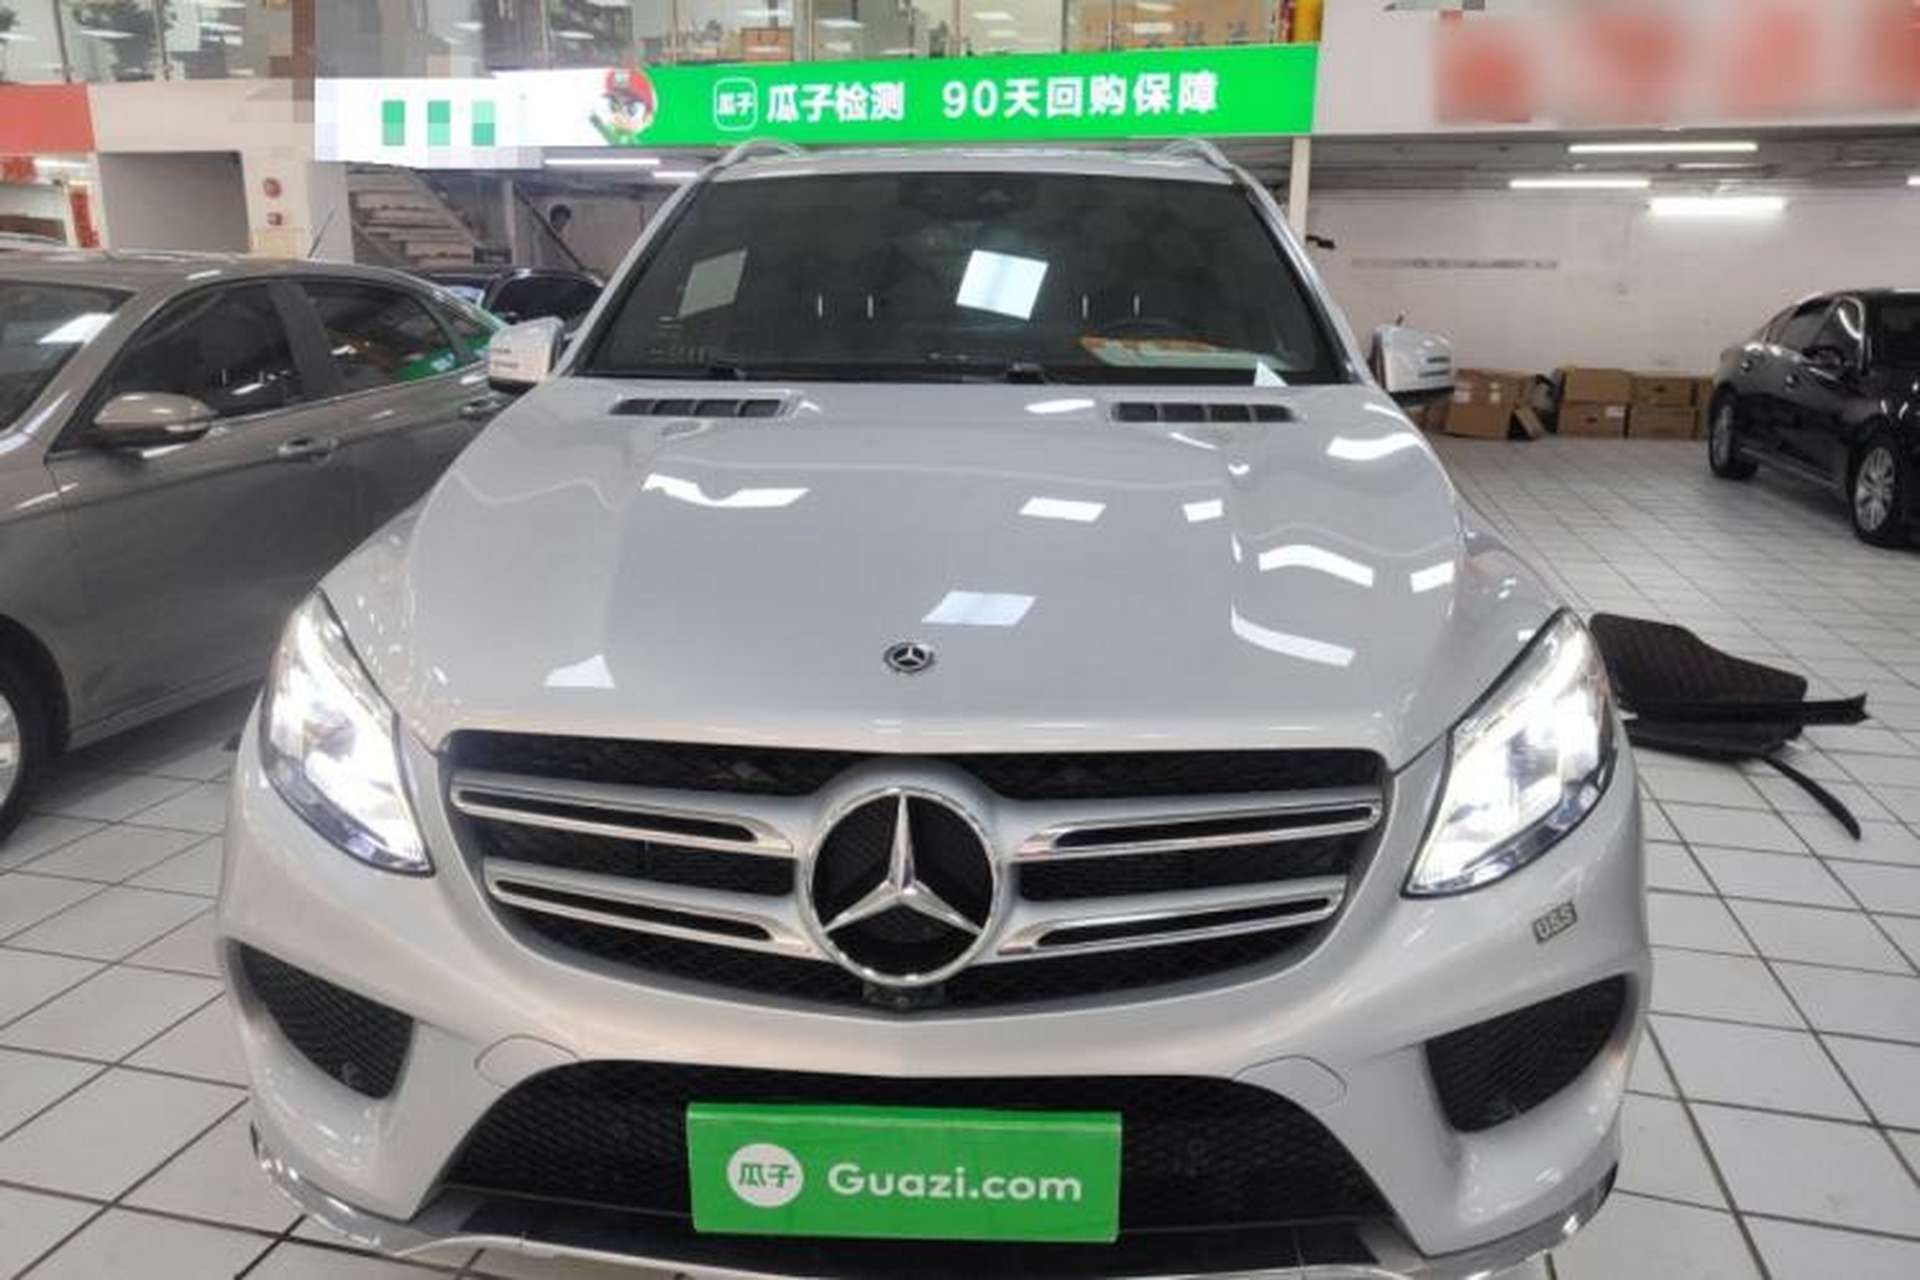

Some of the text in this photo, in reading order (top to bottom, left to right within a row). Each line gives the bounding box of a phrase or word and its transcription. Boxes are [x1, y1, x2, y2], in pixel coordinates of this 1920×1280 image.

[766, 82, 905, 122] 瓜子检测
[941, 70, 1219, 119] 90天回购保障
[738, 1161, 1083, 1202] 瓜子 Guazi.com
